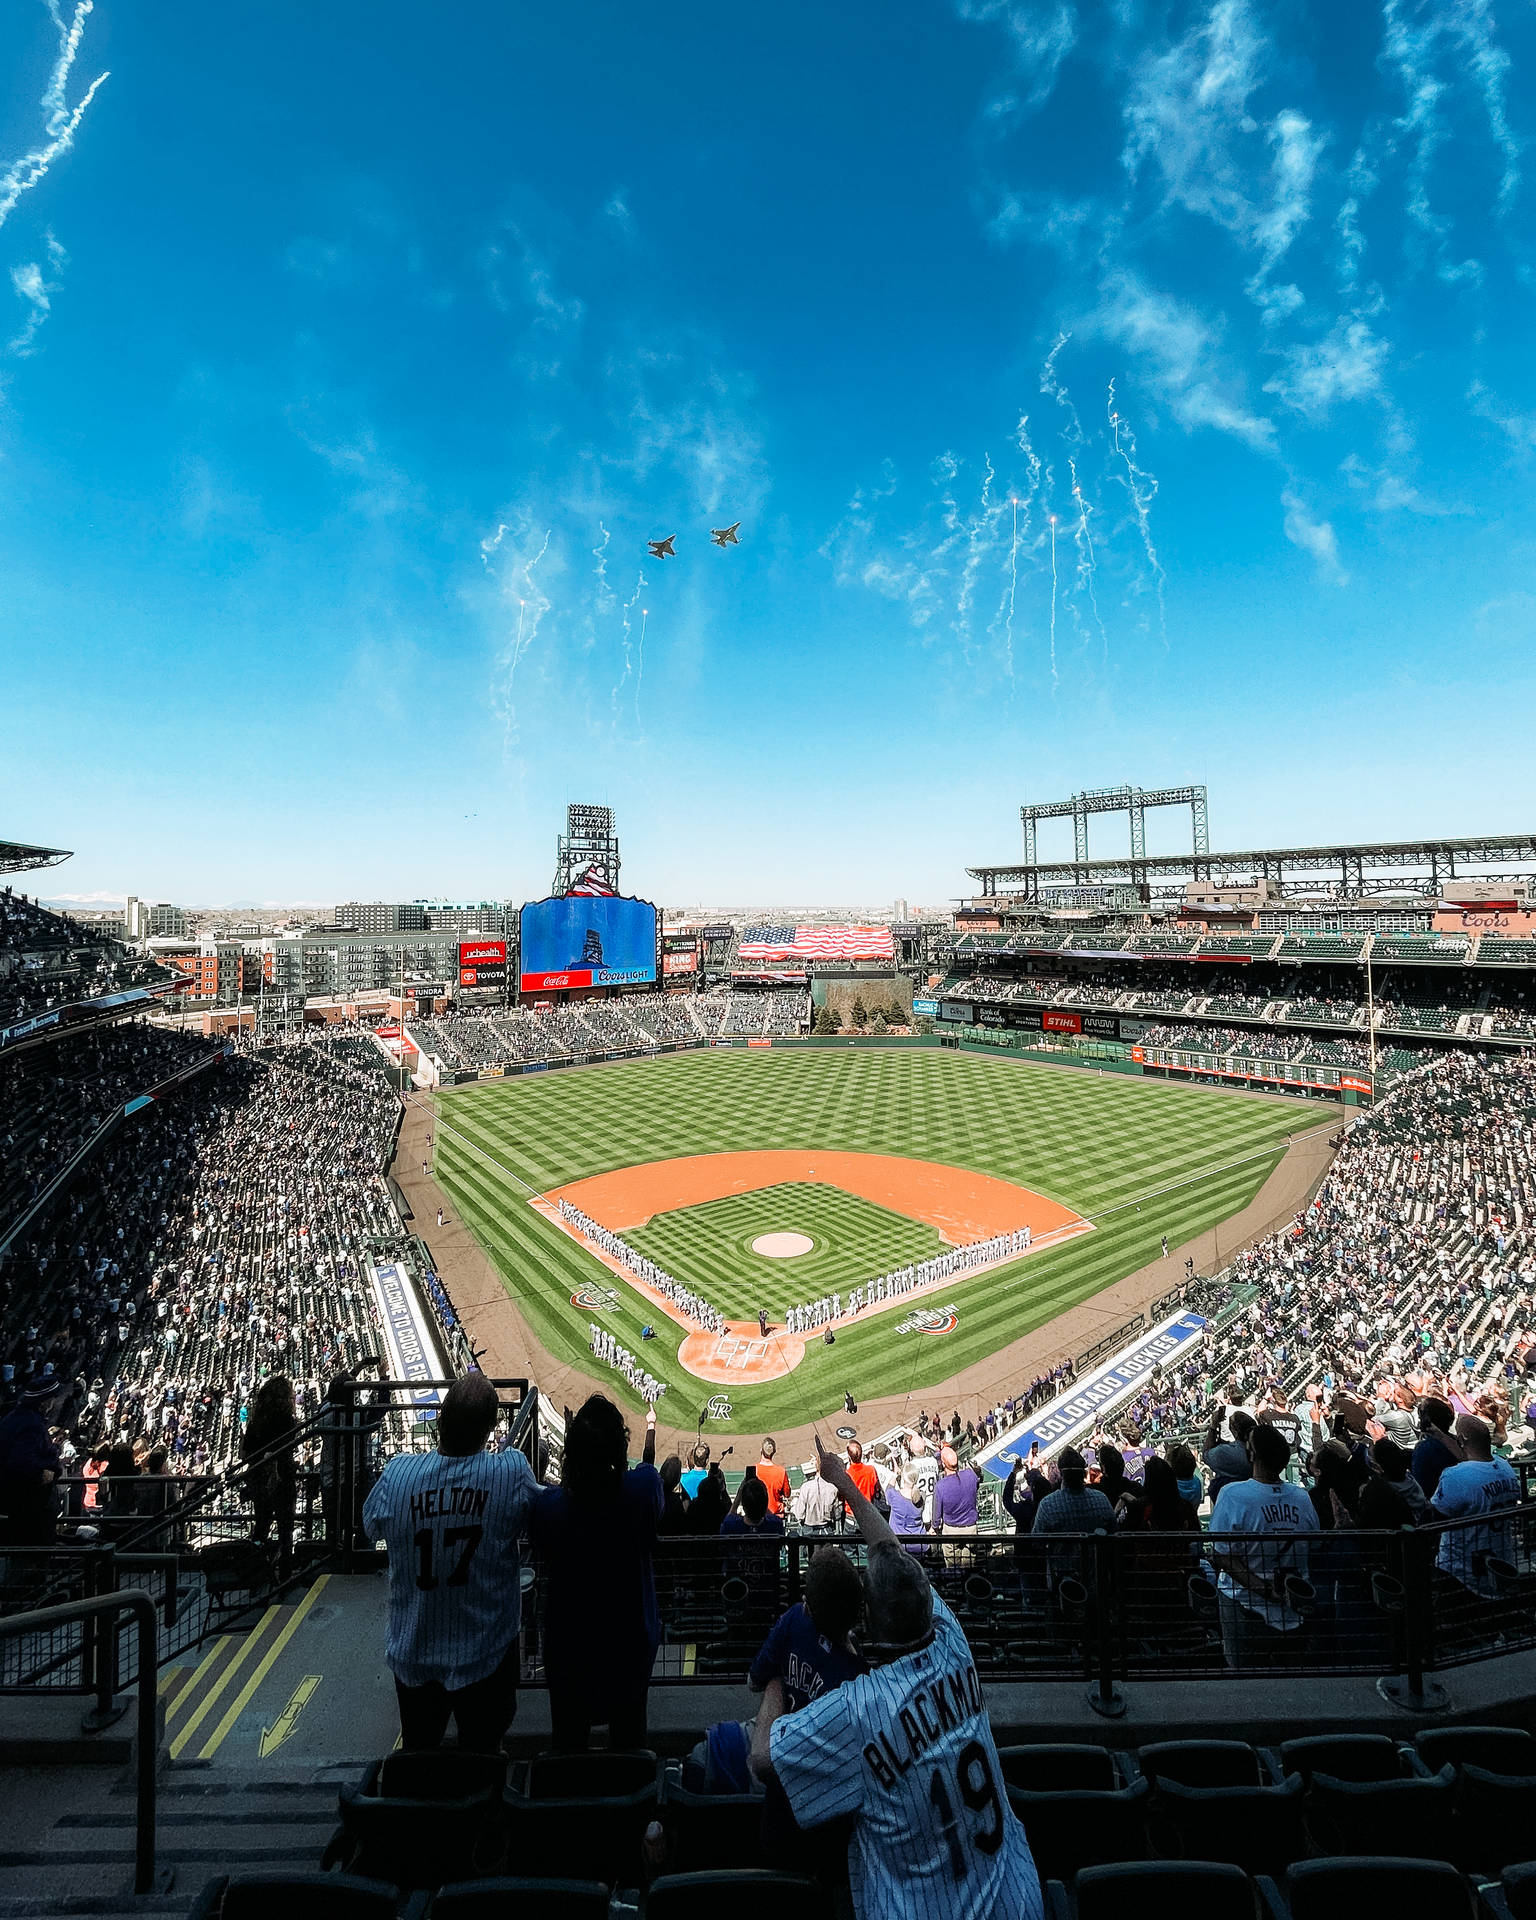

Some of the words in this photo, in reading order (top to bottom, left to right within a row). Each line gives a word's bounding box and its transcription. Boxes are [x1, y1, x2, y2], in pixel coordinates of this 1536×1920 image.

[1461, 913, 1510, 927] Coors
[465, 947, 501, 958] uchealth
[476, 971, 505, 979] TOYOTA
[598, 969, 625, 981] Coors
[626, 970, 648, 979] LIGHT
[415, 988, 443, 996] TUNDRA
[980, 1008, 993, 1016] Bank
[980, 1014, 1005, 1023] Colorado
[1047, 1018, 1076, 1028] STIHL
[382, 1275, 407, 1316] WELCOME
[934, 1303, 960, 1317] DAY
[394, 1317, 411, 1329] TO
[398, 1328, 422, 1364] COORS
[407, 1363, 434, 1399] FIED
[1033, 1375, 1123, 1442] COLORADO
[1115, 1334, 1179, 1381] ROCKIES
[919, 1477, 935, 1493] 28
[410, 1486, 490, 1521] HELTON
[412, 1523, 483, 1592] 17
[929, 1739, 1004, 1881] 19
